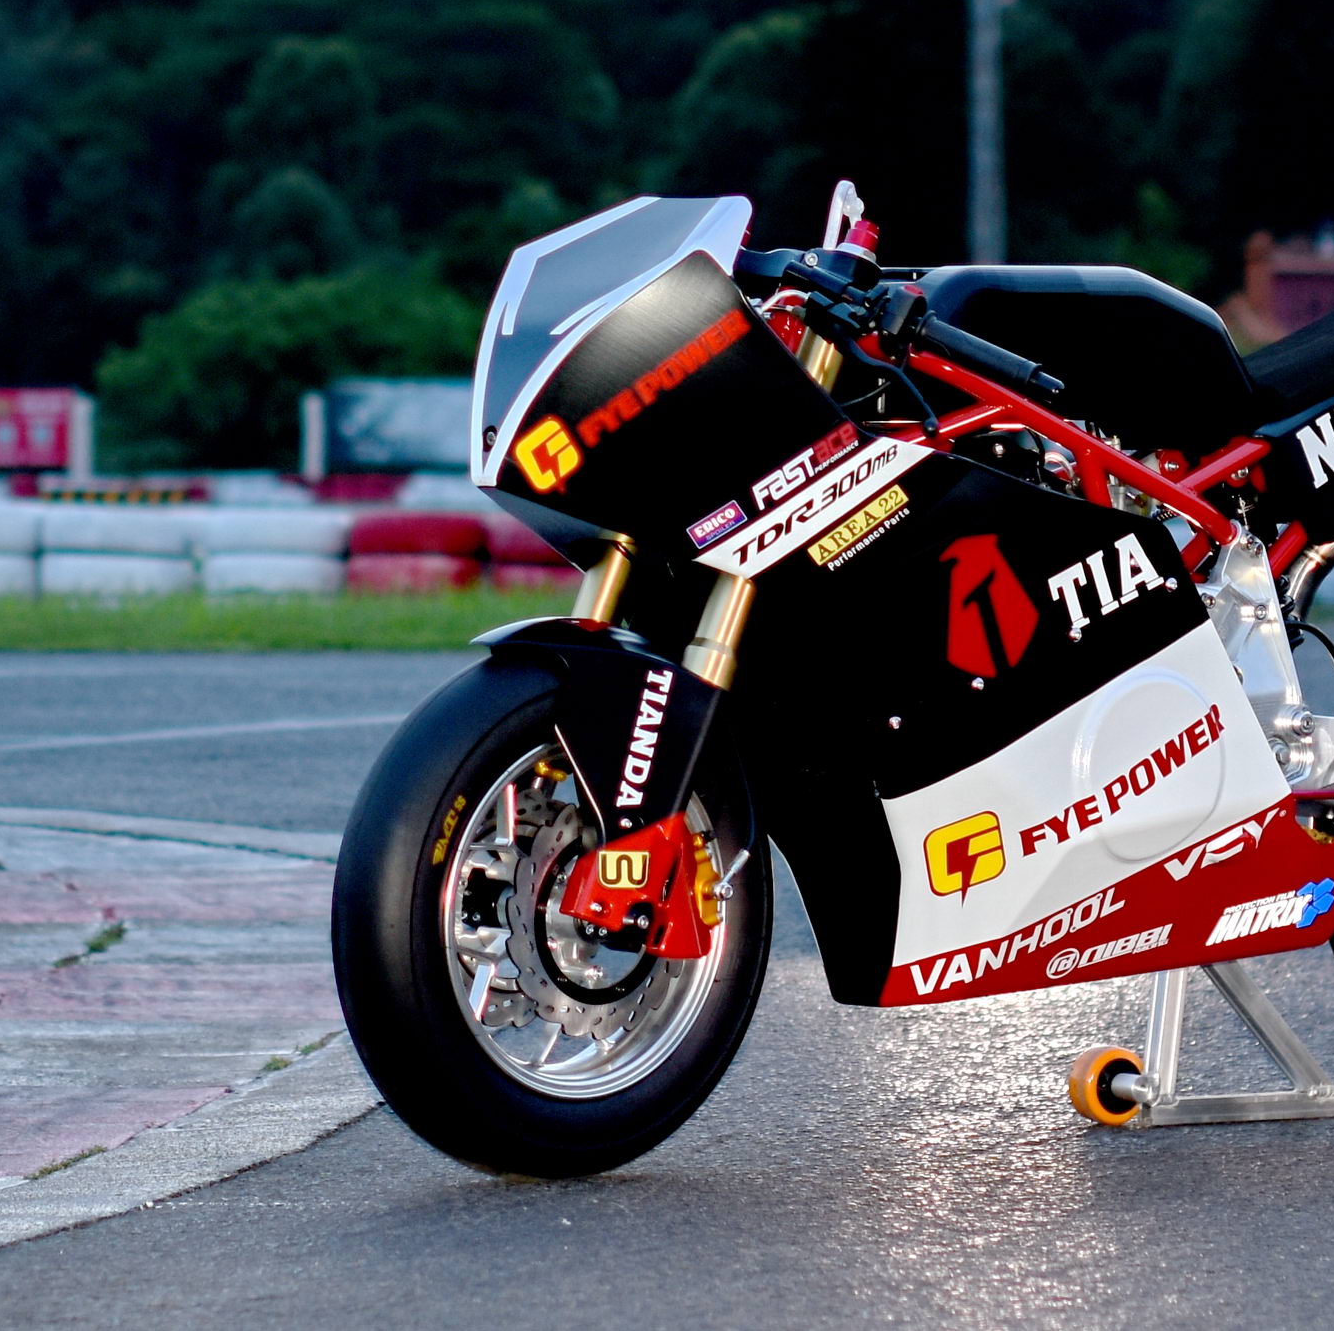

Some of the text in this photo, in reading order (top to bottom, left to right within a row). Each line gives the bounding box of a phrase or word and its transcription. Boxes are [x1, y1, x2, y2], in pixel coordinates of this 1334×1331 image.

[693, 506, 737, 538] ERICO
[817, 489, 906, 562] AREA 22
[827, 507, 911, 572] Performance Parts
[1047, 532, 1165, 630] TIA
[616, 670, 674, 807] TIANDA
[1019, 703, 1226, 858] FYE POWER
[910, 886, 1126, 996] VANHOOL
[1204, 894, 1313, 947] MATRIX
[1222, 897, 1276, 916] PROTECTION
